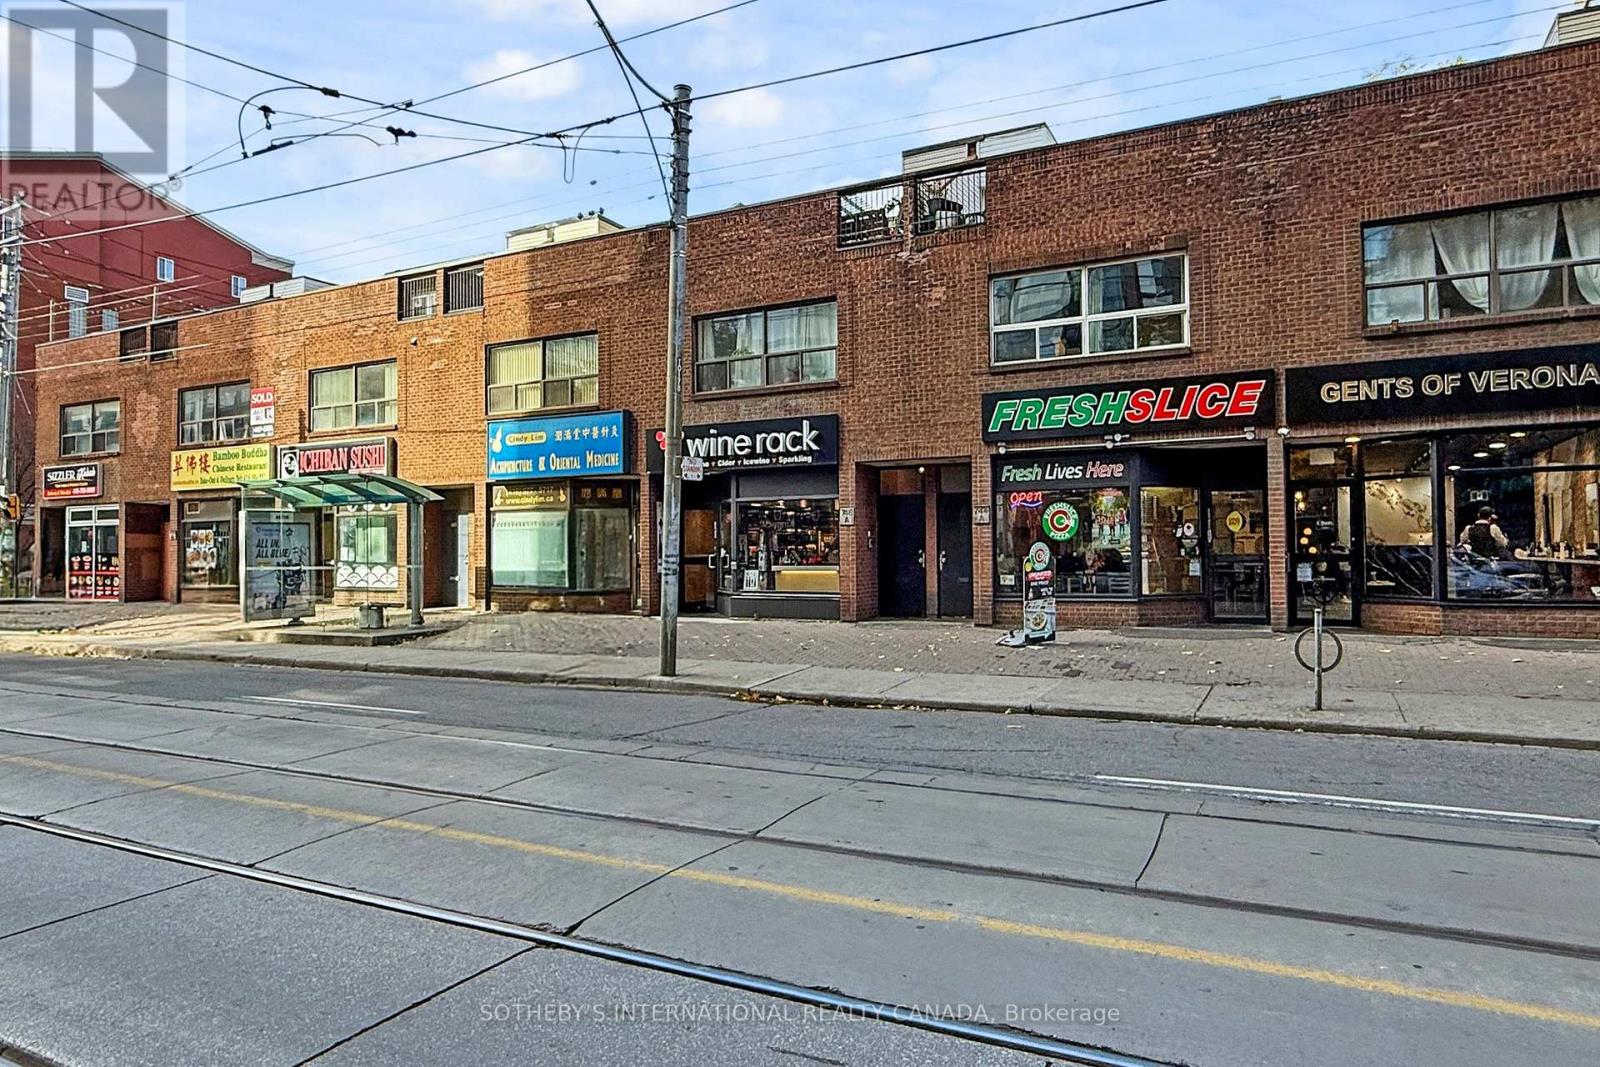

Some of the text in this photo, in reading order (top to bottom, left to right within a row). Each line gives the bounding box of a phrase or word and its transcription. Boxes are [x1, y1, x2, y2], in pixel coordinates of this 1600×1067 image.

[1320, 363, 1600, 402] GENTS OF VERONA
[251, 392, 273, 404] SOLD
[988, 380, 1266, 433] FRESHSLICE
[508, 435, 528, 443] Cindy
[686, 420, 820, 457] wine rack
[212, 447, 268, 461] Bamboo Buddha
[299, 444, 385, 473] ICHIBAN SUSHI
[717, 459, 736, 467] Cider
[778, 455, 812, 464] Sparkling
[212, 464, 235, 473] Chinese
[1001, 461, 1124, 482] Fresh Lives Here
[47, 470, 76, 481] SIZZLER
[256, 539, 269, 548] ALL
[256, 549, 269, 558] ALL
